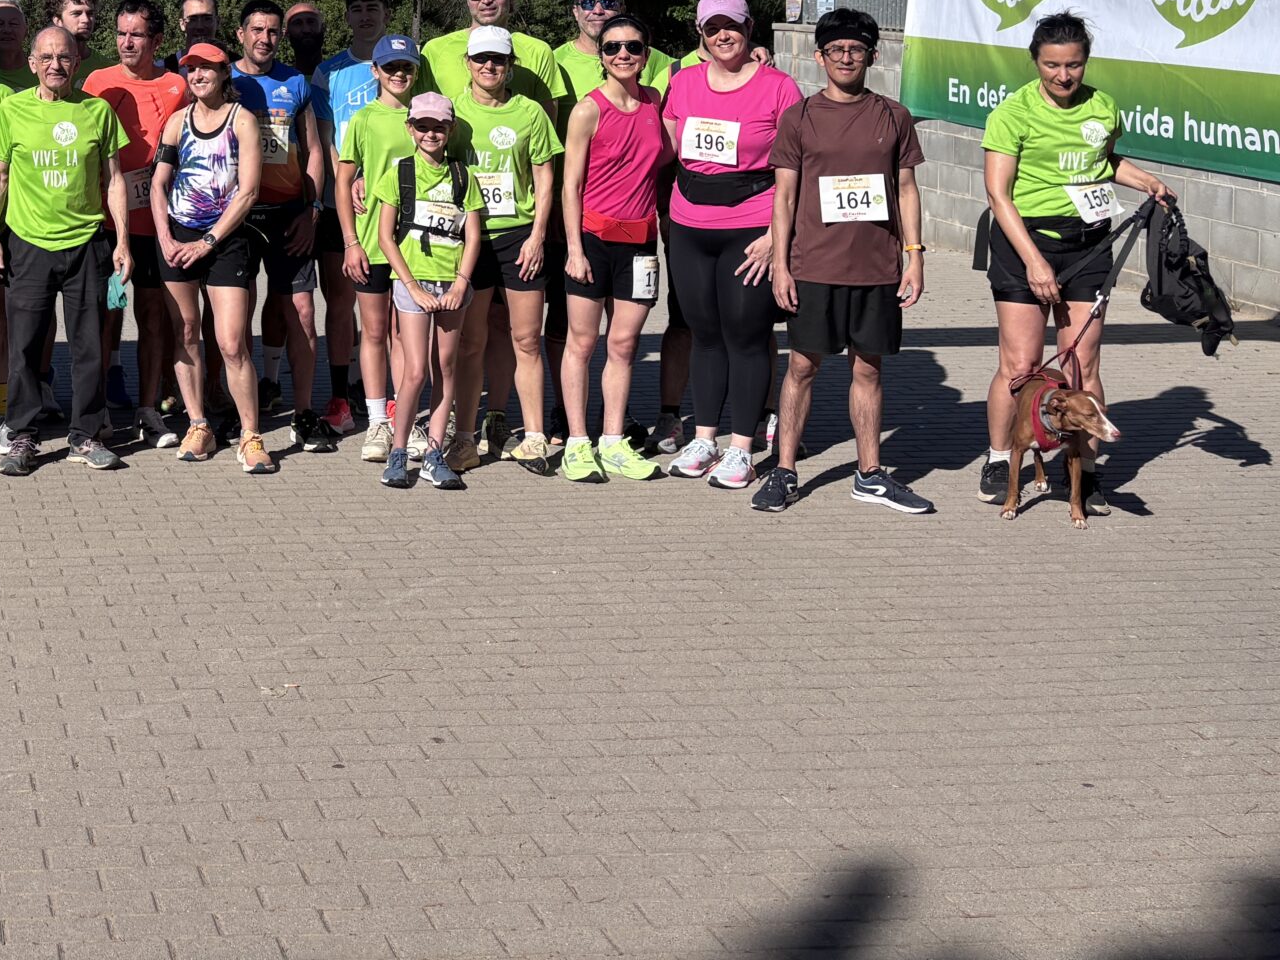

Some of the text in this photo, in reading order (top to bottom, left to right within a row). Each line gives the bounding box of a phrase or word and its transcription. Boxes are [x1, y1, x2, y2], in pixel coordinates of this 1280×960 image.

[948, 77, 970, 104] En
[976, 82, 1016, 109] def
[1120, 104, 1174, 138] vida
[1183, 111, 1280, 154] human
[261, 137, 279, 154] 99
[695, 132, 725, 152] 196
[32, 149, 78, 167] VIVE LA
[465, 149, 492, 169] VIVE
[1058, 151, 1089, 170] VIVE
[42, 170, 69, 188] VIDA
[134, 181, 150, 198] 18
[481, 187, 503, 204] 86
[1084, 187, 1110, 210] 156
[835, 190, 872, 210] 164
[427, 214, 455, 232] 187
[645, 270, 658, 287] 17
